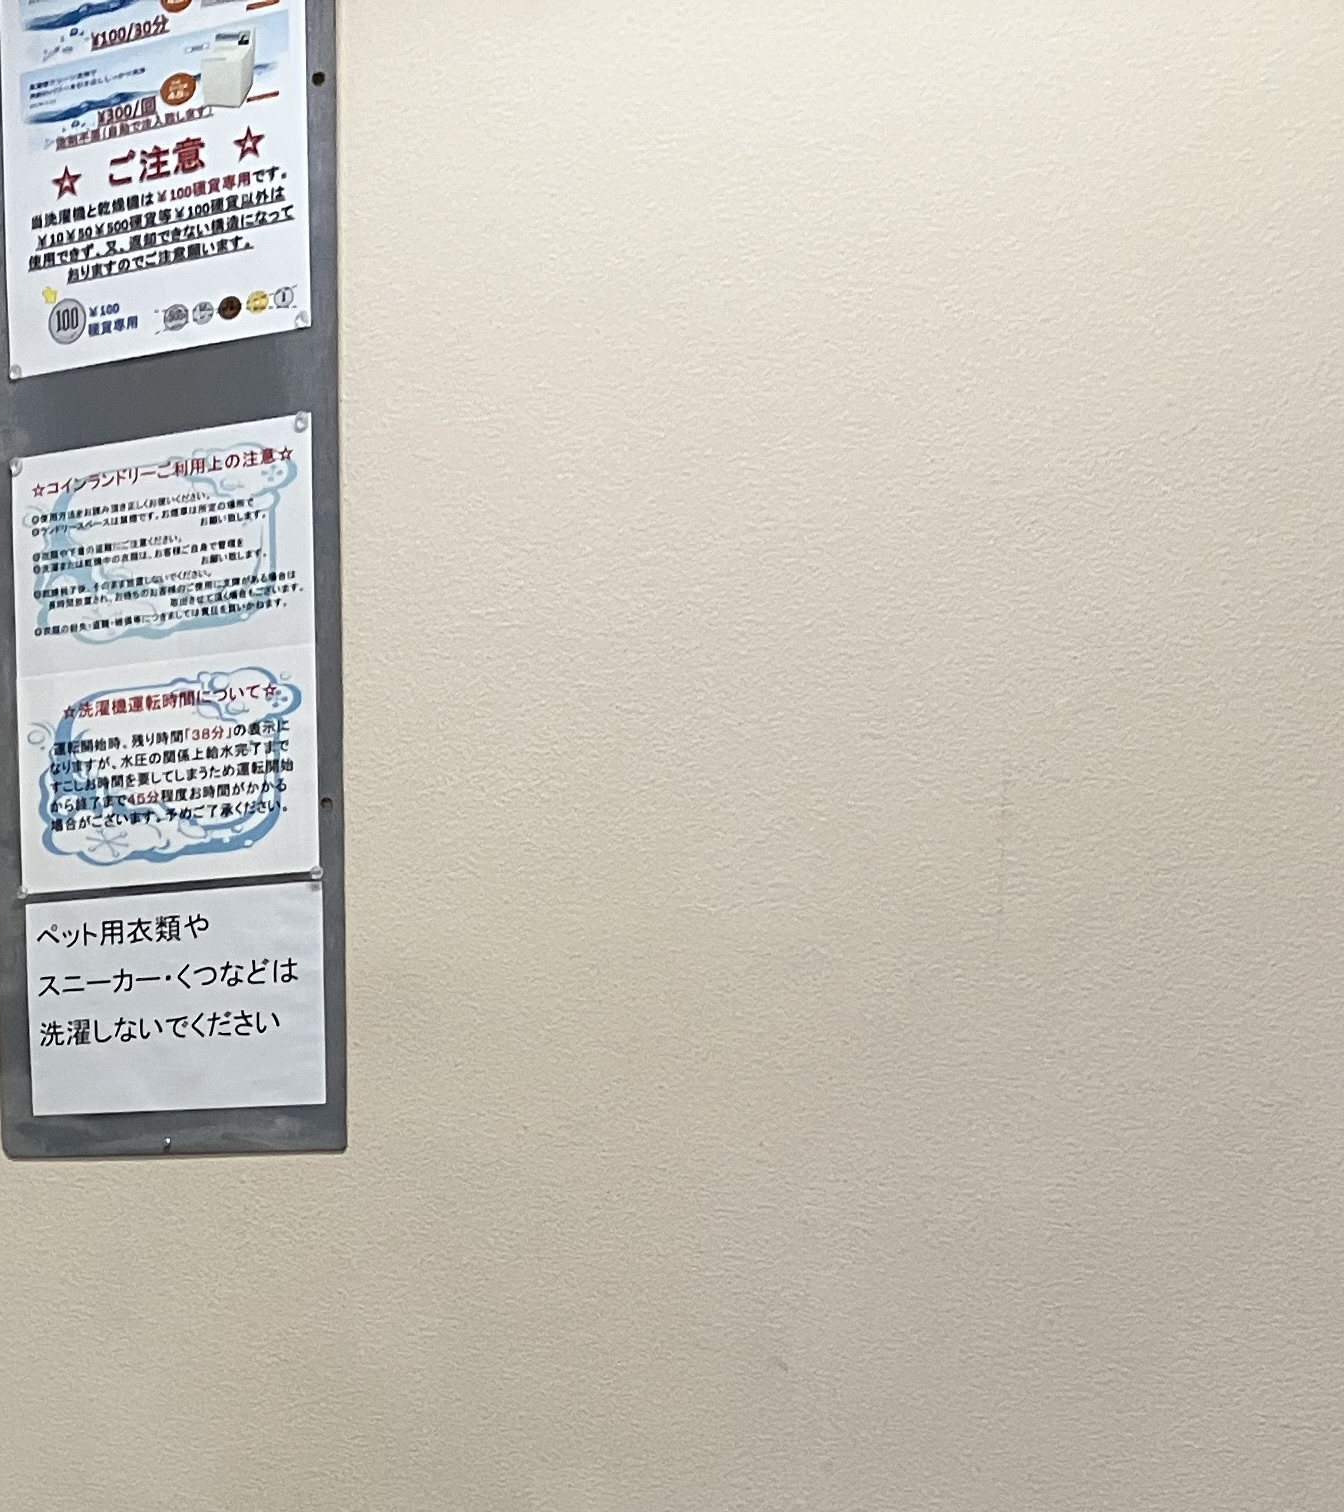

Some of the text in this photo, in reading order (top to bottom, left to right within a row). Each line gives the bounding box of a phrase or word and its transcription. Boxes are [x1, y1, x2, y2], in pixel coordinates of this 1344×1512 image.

[108, 137, 205, 186] ご注意
[55, 306, 79, 332] 100
[37, 913, 209, 948] ペット用衣類や
[38, 957, 298, 997] スニーカー・くつなどは
[40, 1009, 280, 1046] 洗濯しないでください
